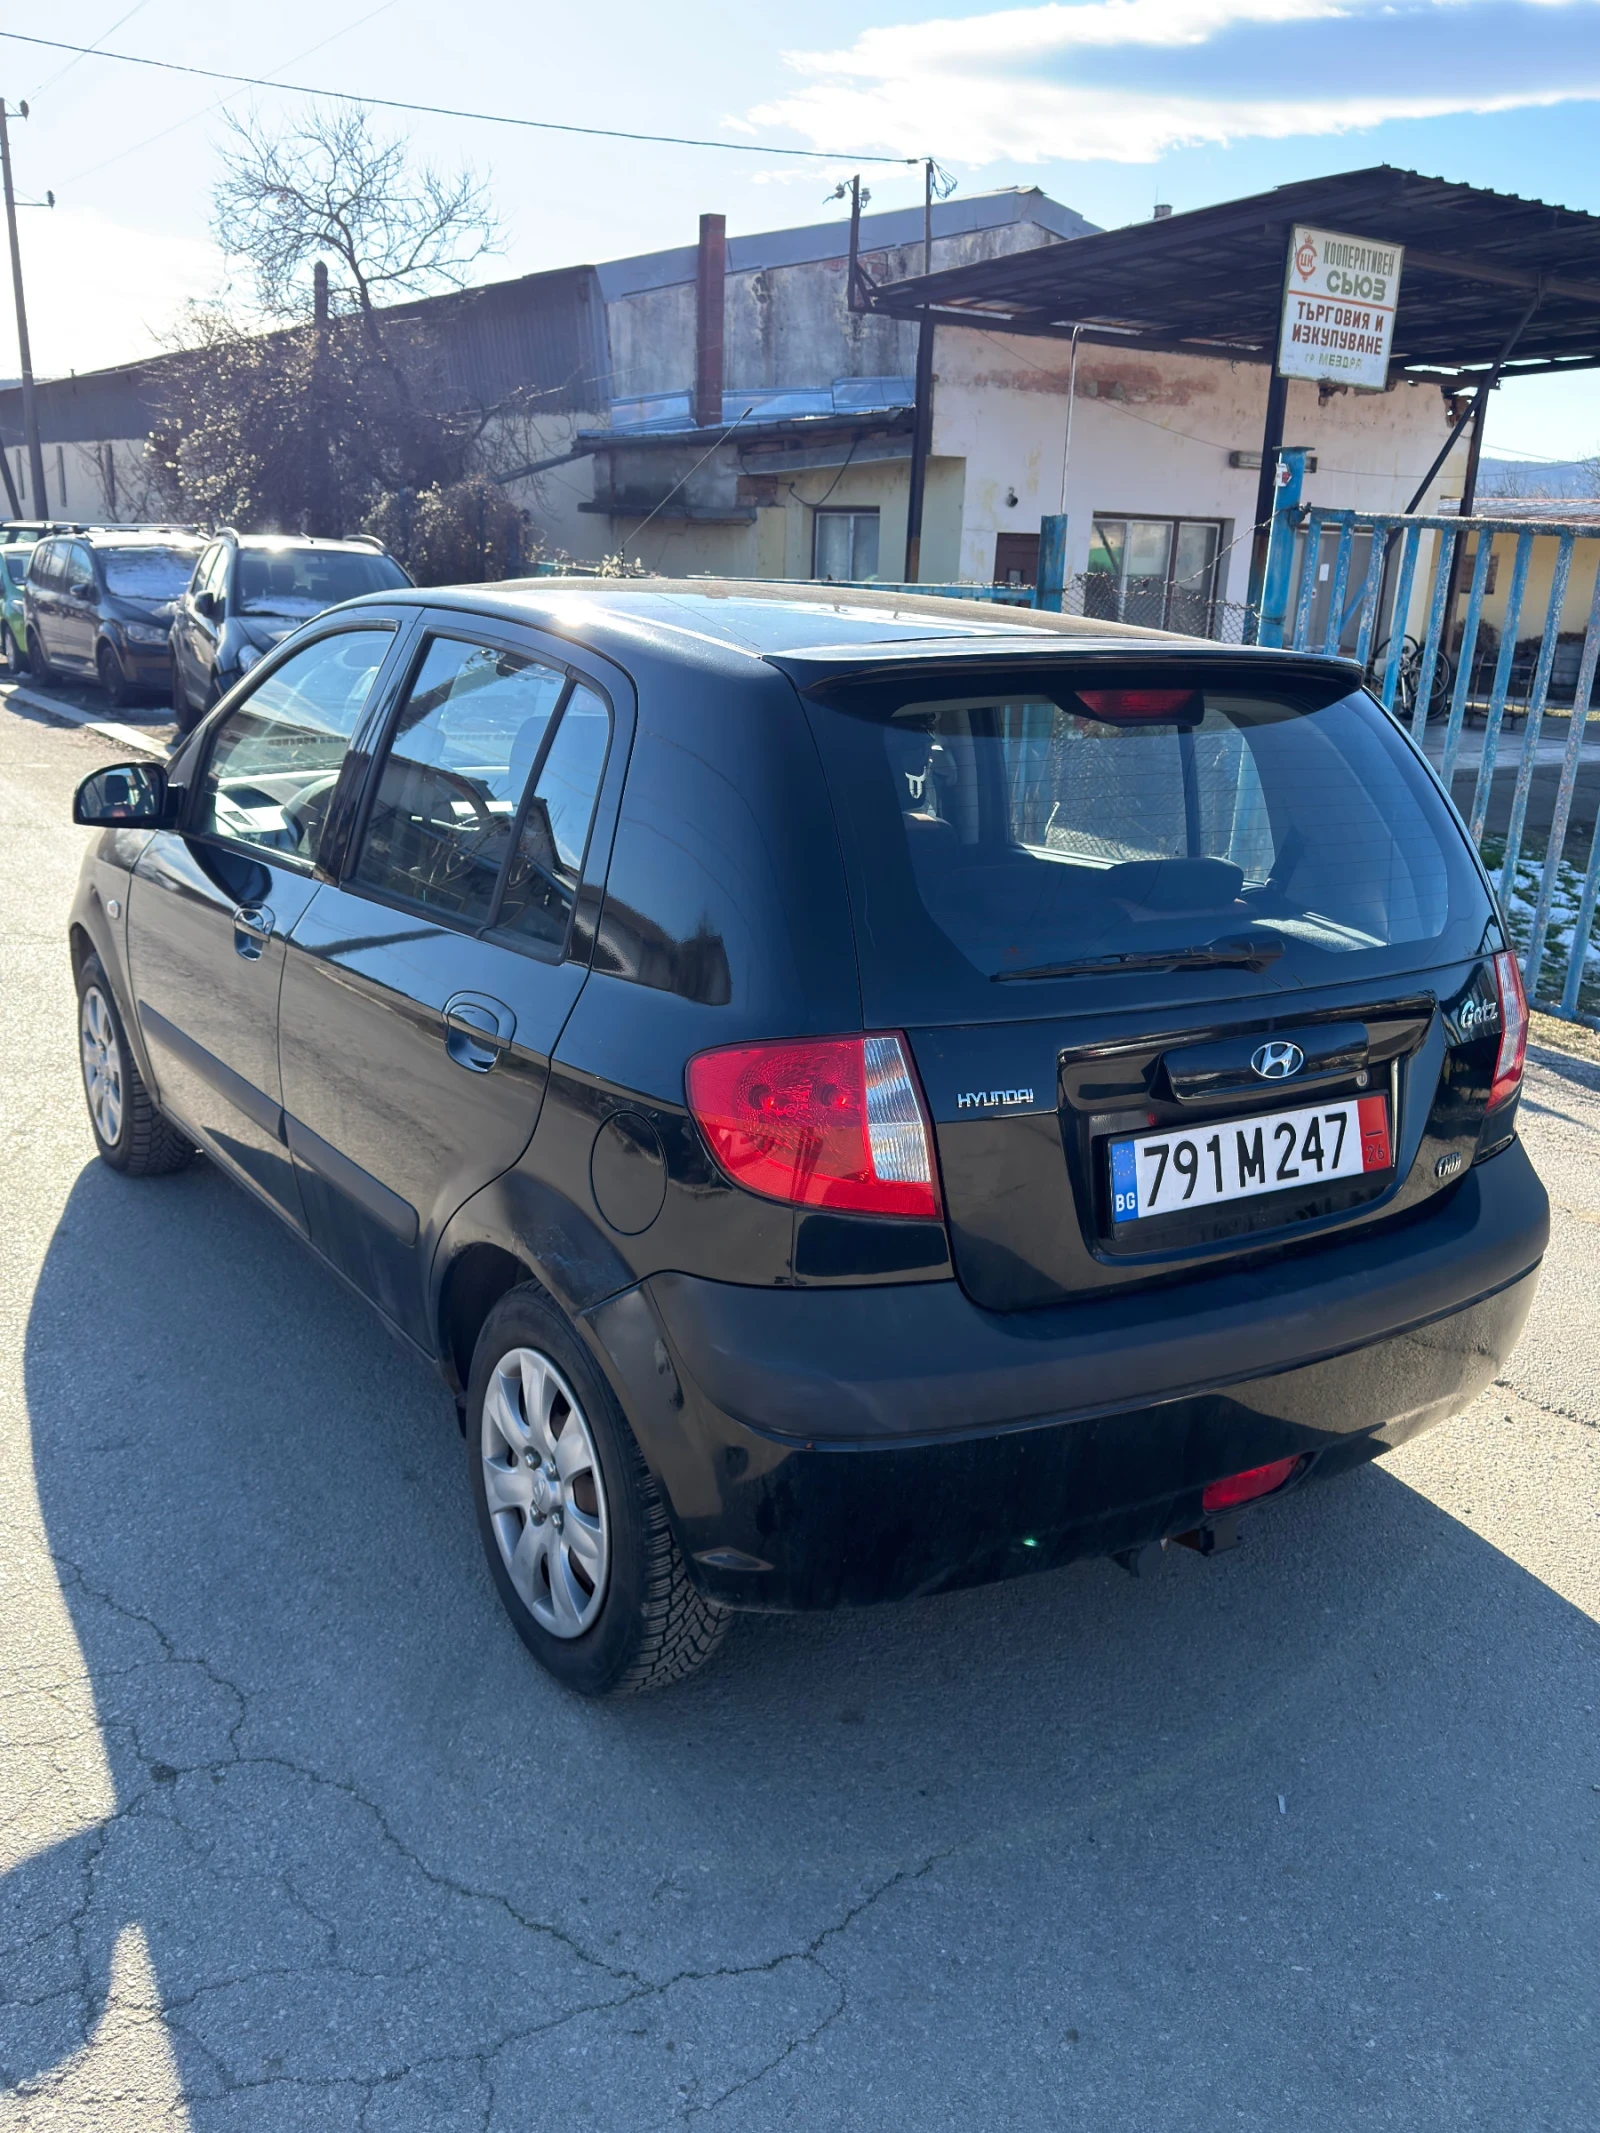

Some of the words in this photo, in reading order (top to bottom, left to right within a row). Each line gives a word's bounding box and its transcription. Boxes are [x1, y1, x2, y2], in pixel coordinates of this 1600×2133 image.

[1323, 240, 1395, 277] КООПЕРАТИВЕН
[1374, 315, 1385, 333] И
[1291, 323, 1383, 355] ИЗКУПУВАНЕ
[1460, 998, 1498, 1029] Getz
[957, 1088, 1034, 1108] HYUNDAI
[1115, 1191, 1136, 1212] BG
